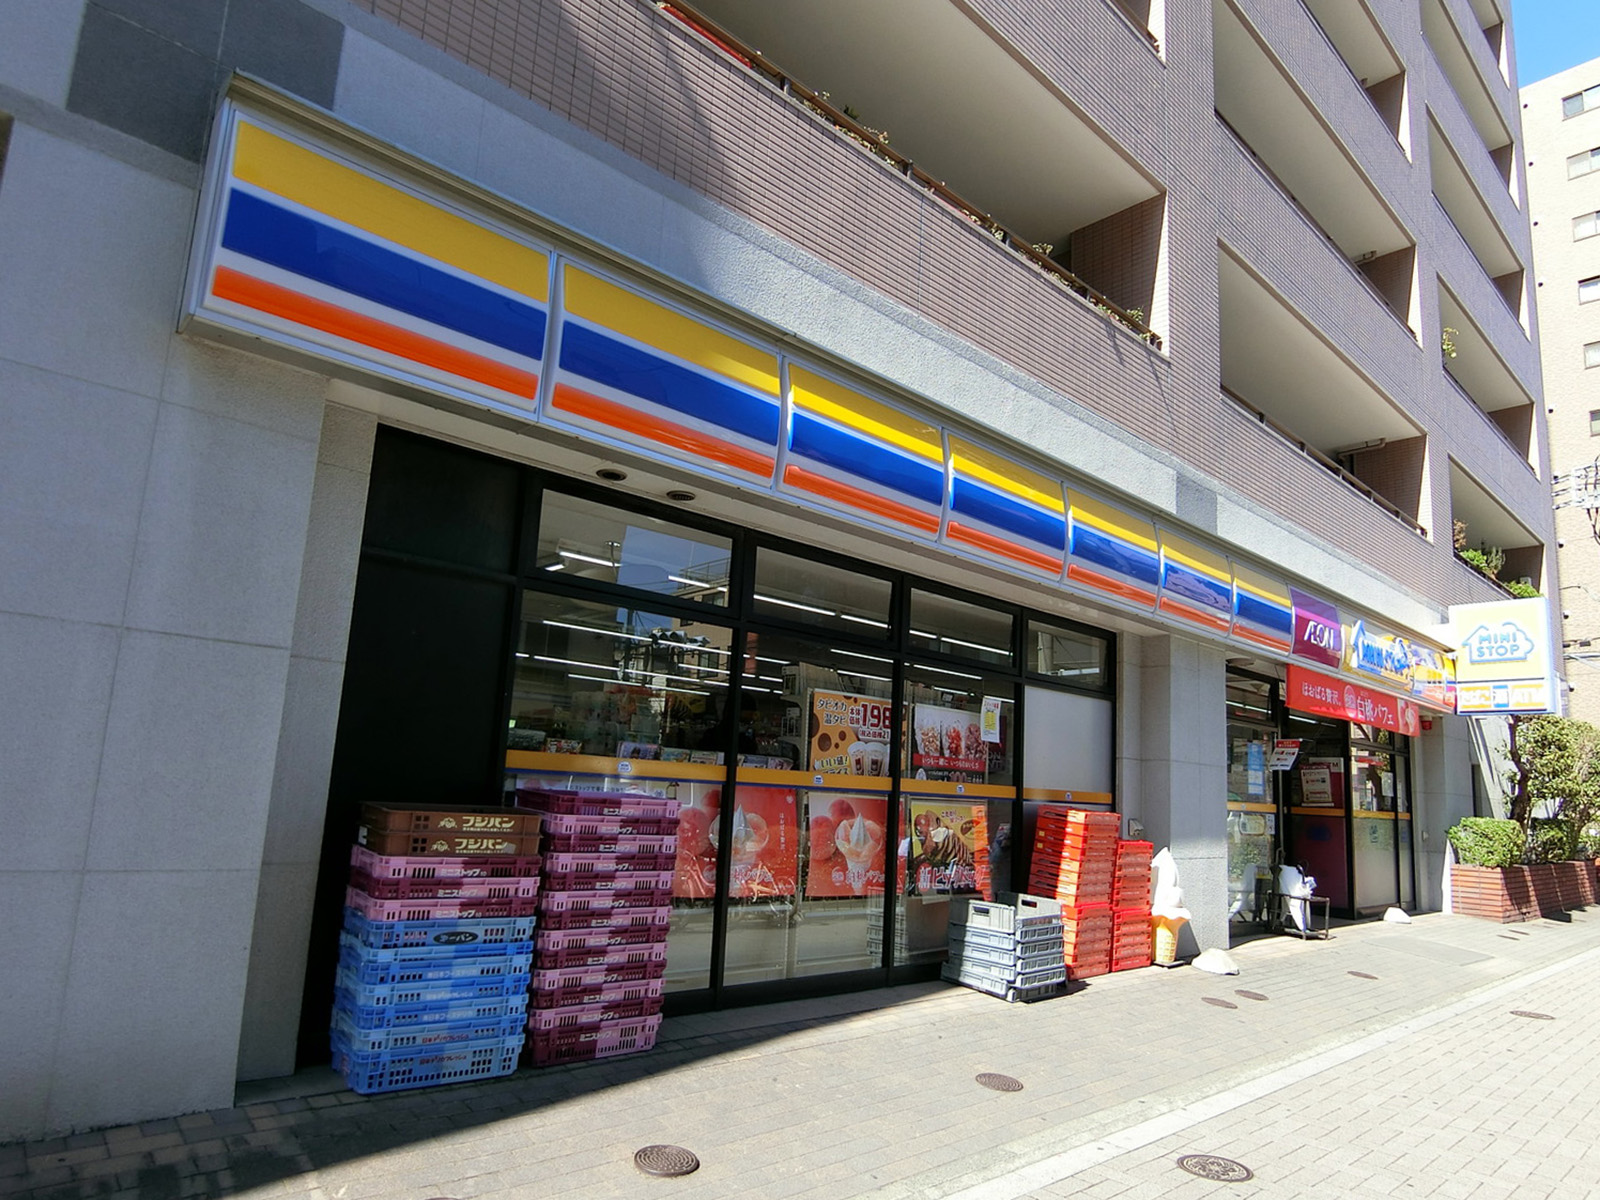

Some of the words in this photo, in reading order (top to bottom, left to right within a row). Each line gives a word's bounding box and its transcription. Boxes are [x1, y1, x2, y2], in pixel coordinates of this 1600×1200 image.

[1479, 632, 1517, 645] MINI
[1477, 644, 1520, 658] STOP
[862, 703, 891, 729] 198
[462, 816, 515, 828] フジパン
[455, 839, 508, 850] フジパン
[440, 868, 481, 877] ミニストップ
[437, 889, 478, 898] ミニストップ
[435, 910, 476, 918] ミニストップ
